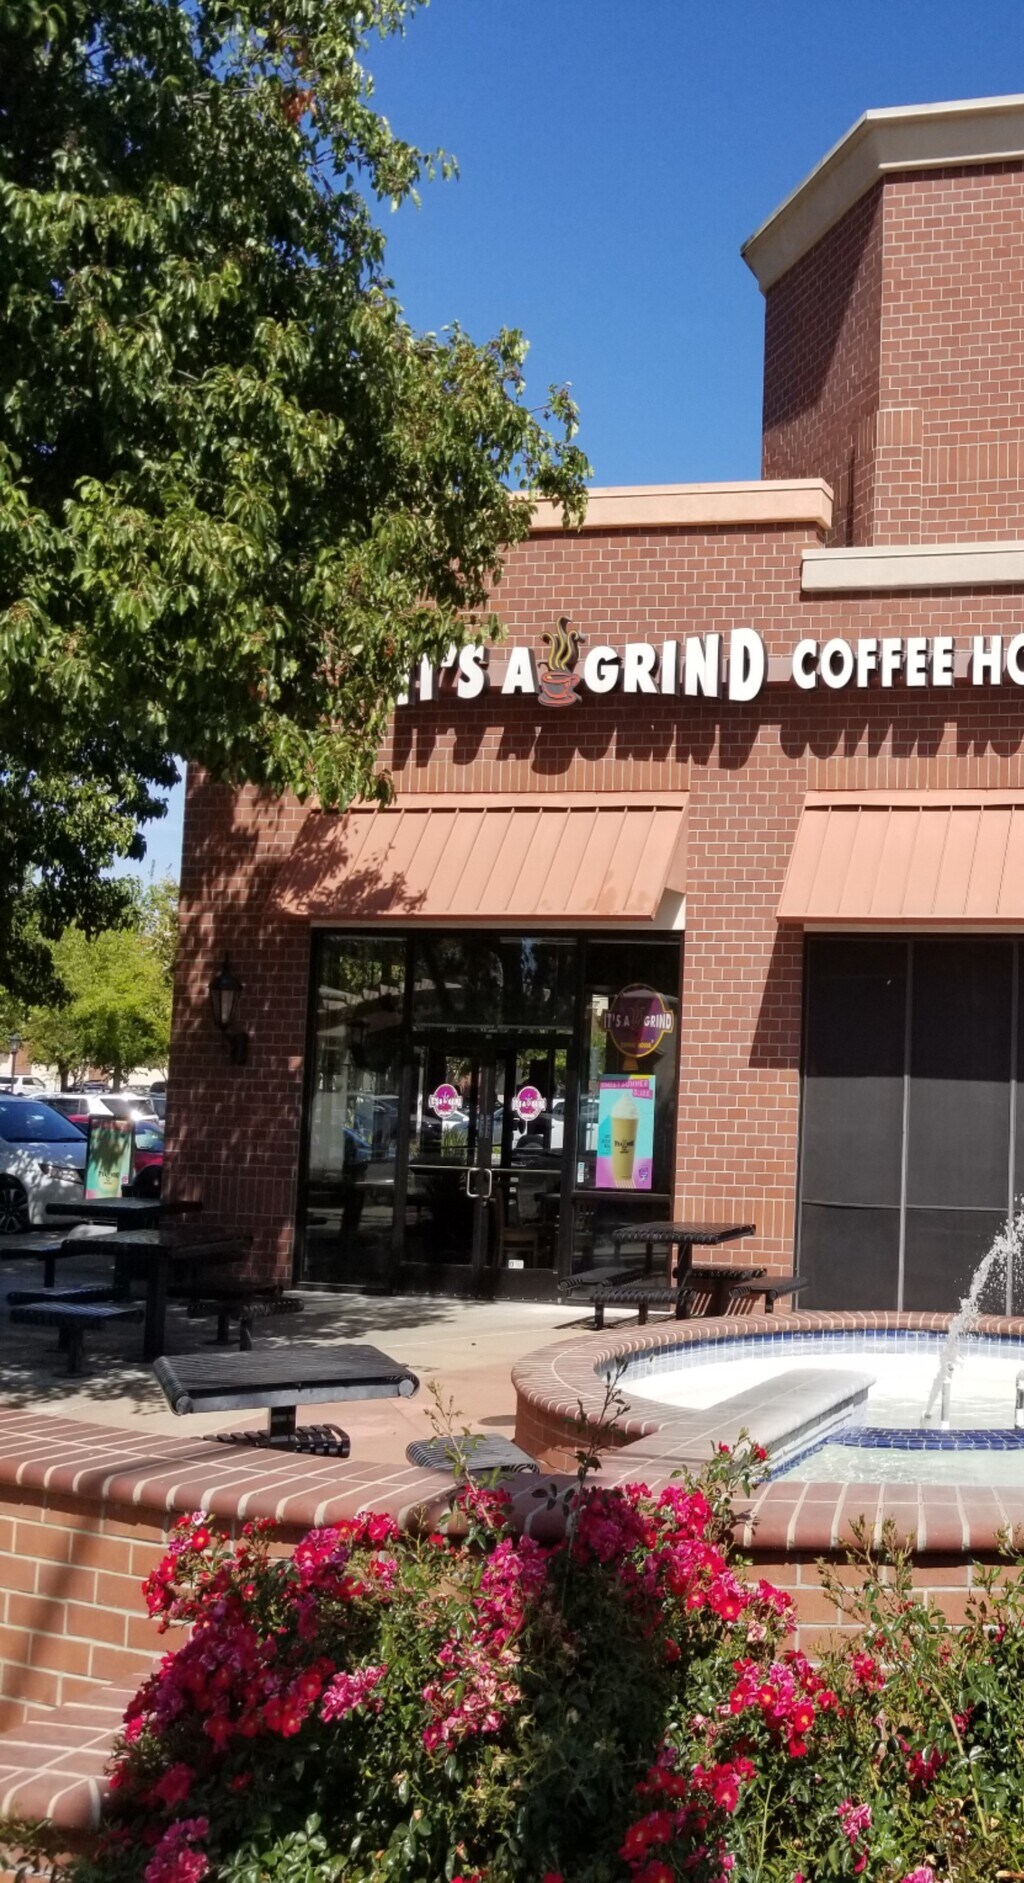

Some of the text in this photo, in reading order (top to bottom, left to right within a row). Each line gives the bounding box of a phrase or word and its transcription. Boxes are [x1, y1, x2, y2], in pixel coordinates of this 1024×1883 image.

[501, 646, 538, 695] A
[584, 627, 767, 702] GRIND
[790, 635, 956, 690] COFFEE
[604, 1013, 672, 1030] IT'S A GRIND
